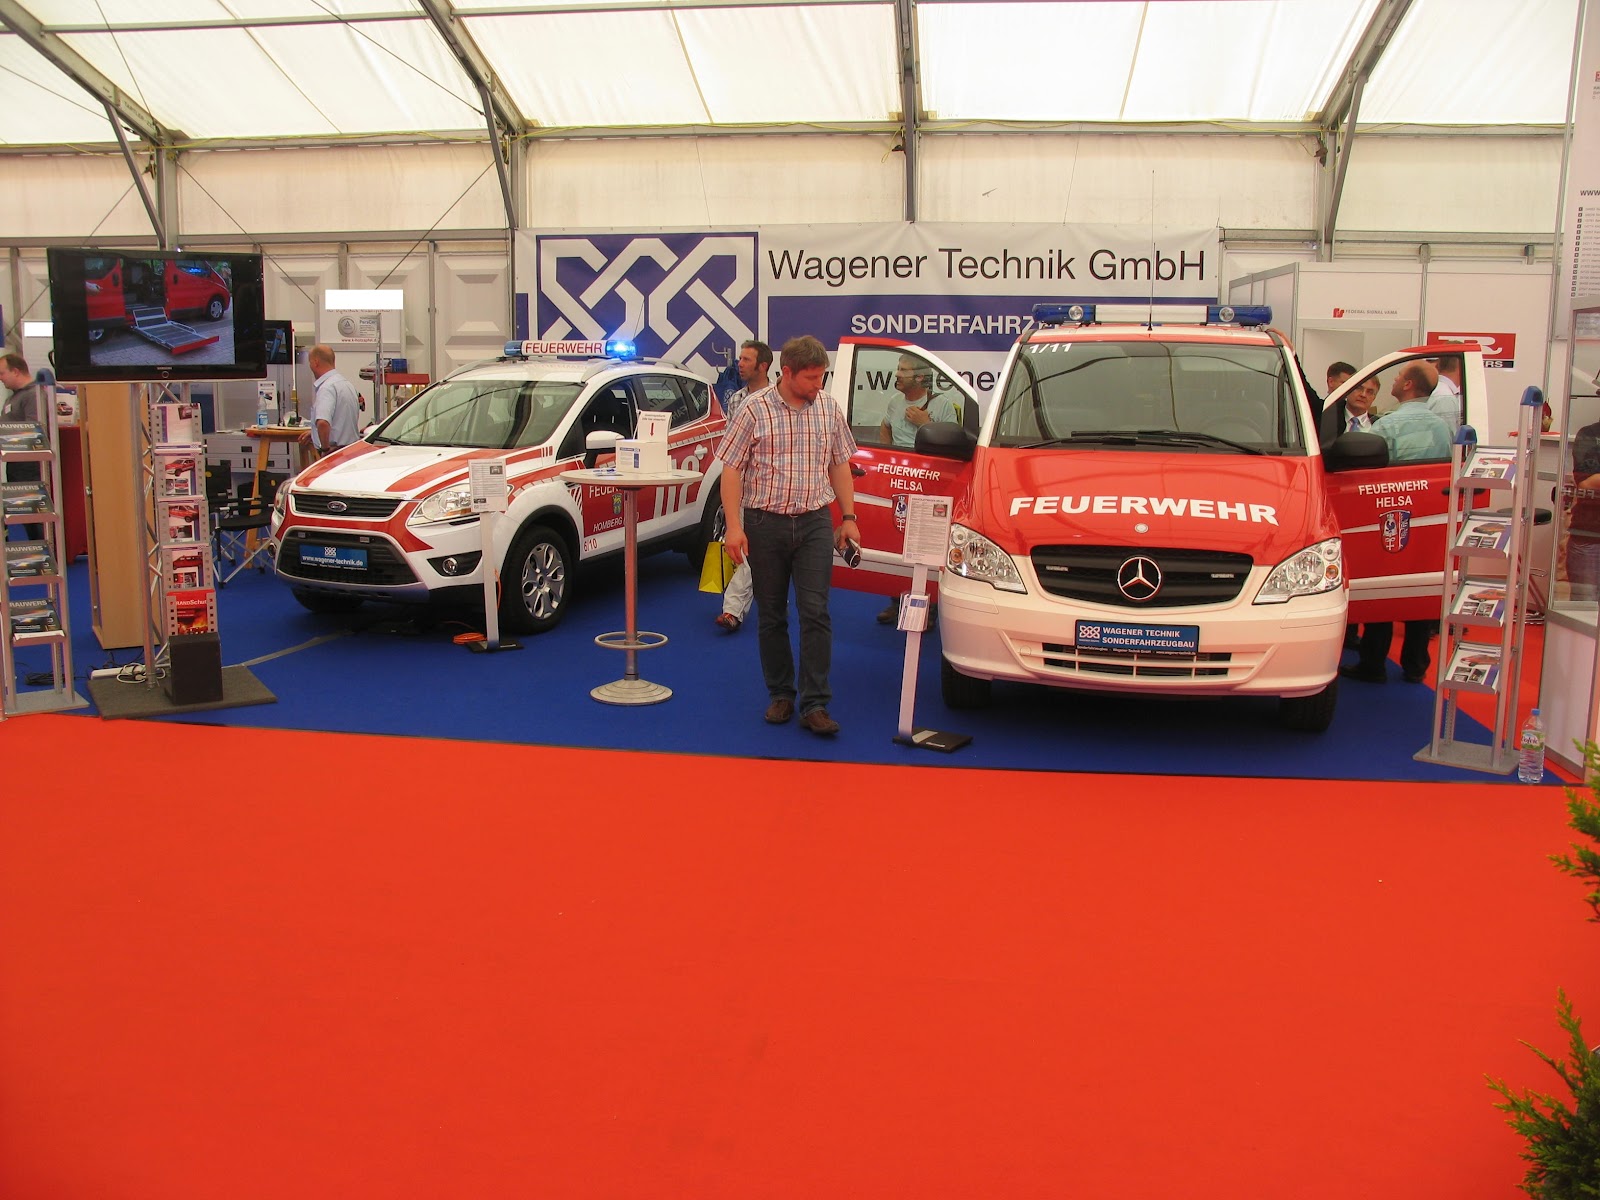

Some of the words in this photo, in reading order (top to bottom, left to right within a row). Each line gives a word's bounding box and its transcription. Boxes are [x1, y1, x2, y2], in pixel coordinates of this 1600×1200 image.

[768, 249, 927, 287] Wagener
[938, 248, 1076, 280] Technik
[1088, 249, 1205, 281] GmbH
[525, 342, 602, 354] FEUERWEHR
[1029, 342, 1073, 354] 1/11
[877, 463, 940, 481] FEUERWEHR
[890, 478, 923, 492] HELSA
[1358, 479, 1429, 496] FEUERWEHR
[1376, 495, 1413, 508] HELSA
[1009, 496, 1279, 526] FEUERWEHR
[593, 516, 623, 533] HOMBERG
[583, 538, 598, 552] 6/10
[9, 599, 48, 608] RAUWERS
[1102, 627, 1144, 637] WAGENER
[1145, 629, 1181, 638] TECHNIK
[1102, 637, 1195, 648] SONDERFAHRZEUGBAU
